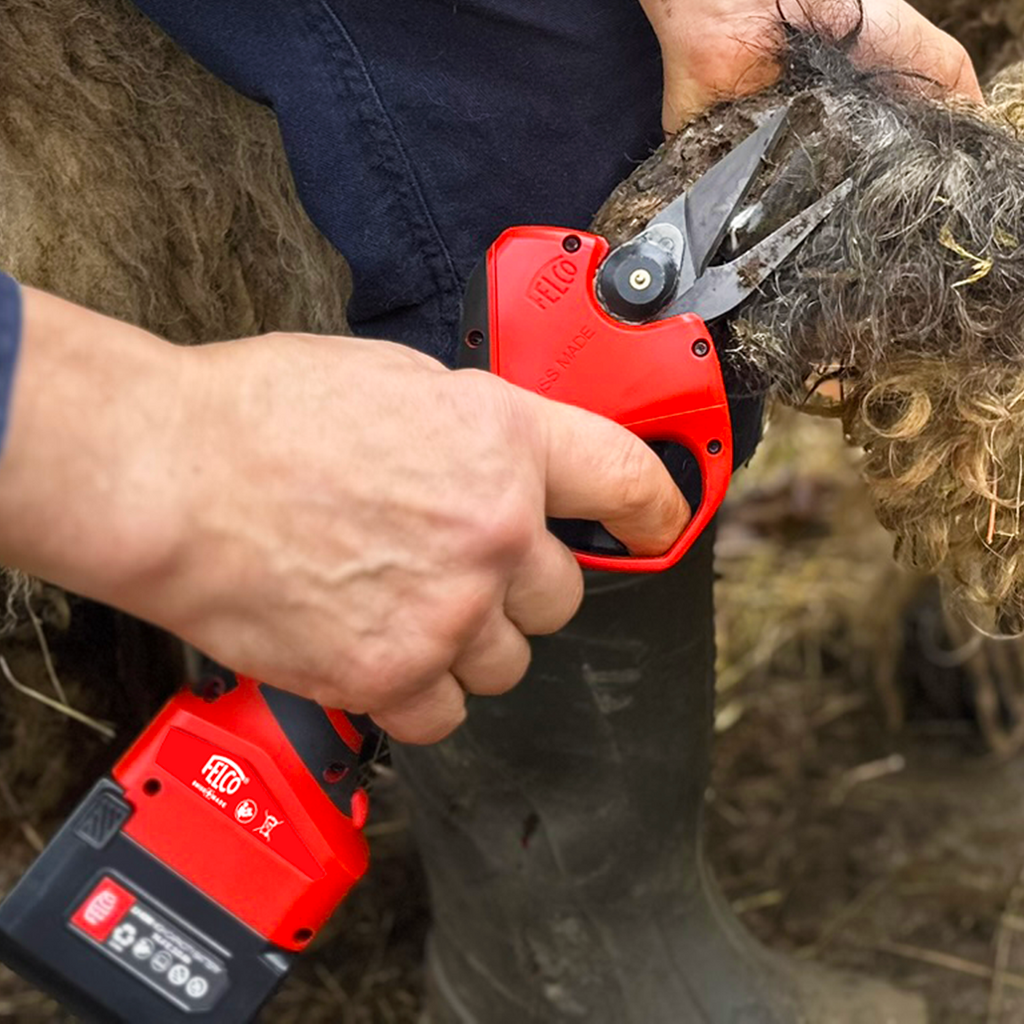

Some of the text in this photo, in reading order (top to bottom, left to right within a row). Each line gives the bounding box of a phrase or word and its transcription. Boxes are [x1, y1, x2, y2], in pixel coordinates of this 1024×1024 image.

[525, 254, 578, 310] FELCO
[556, 325, 596, 369] MADE
[201, 754, 246, 795] FELCO
